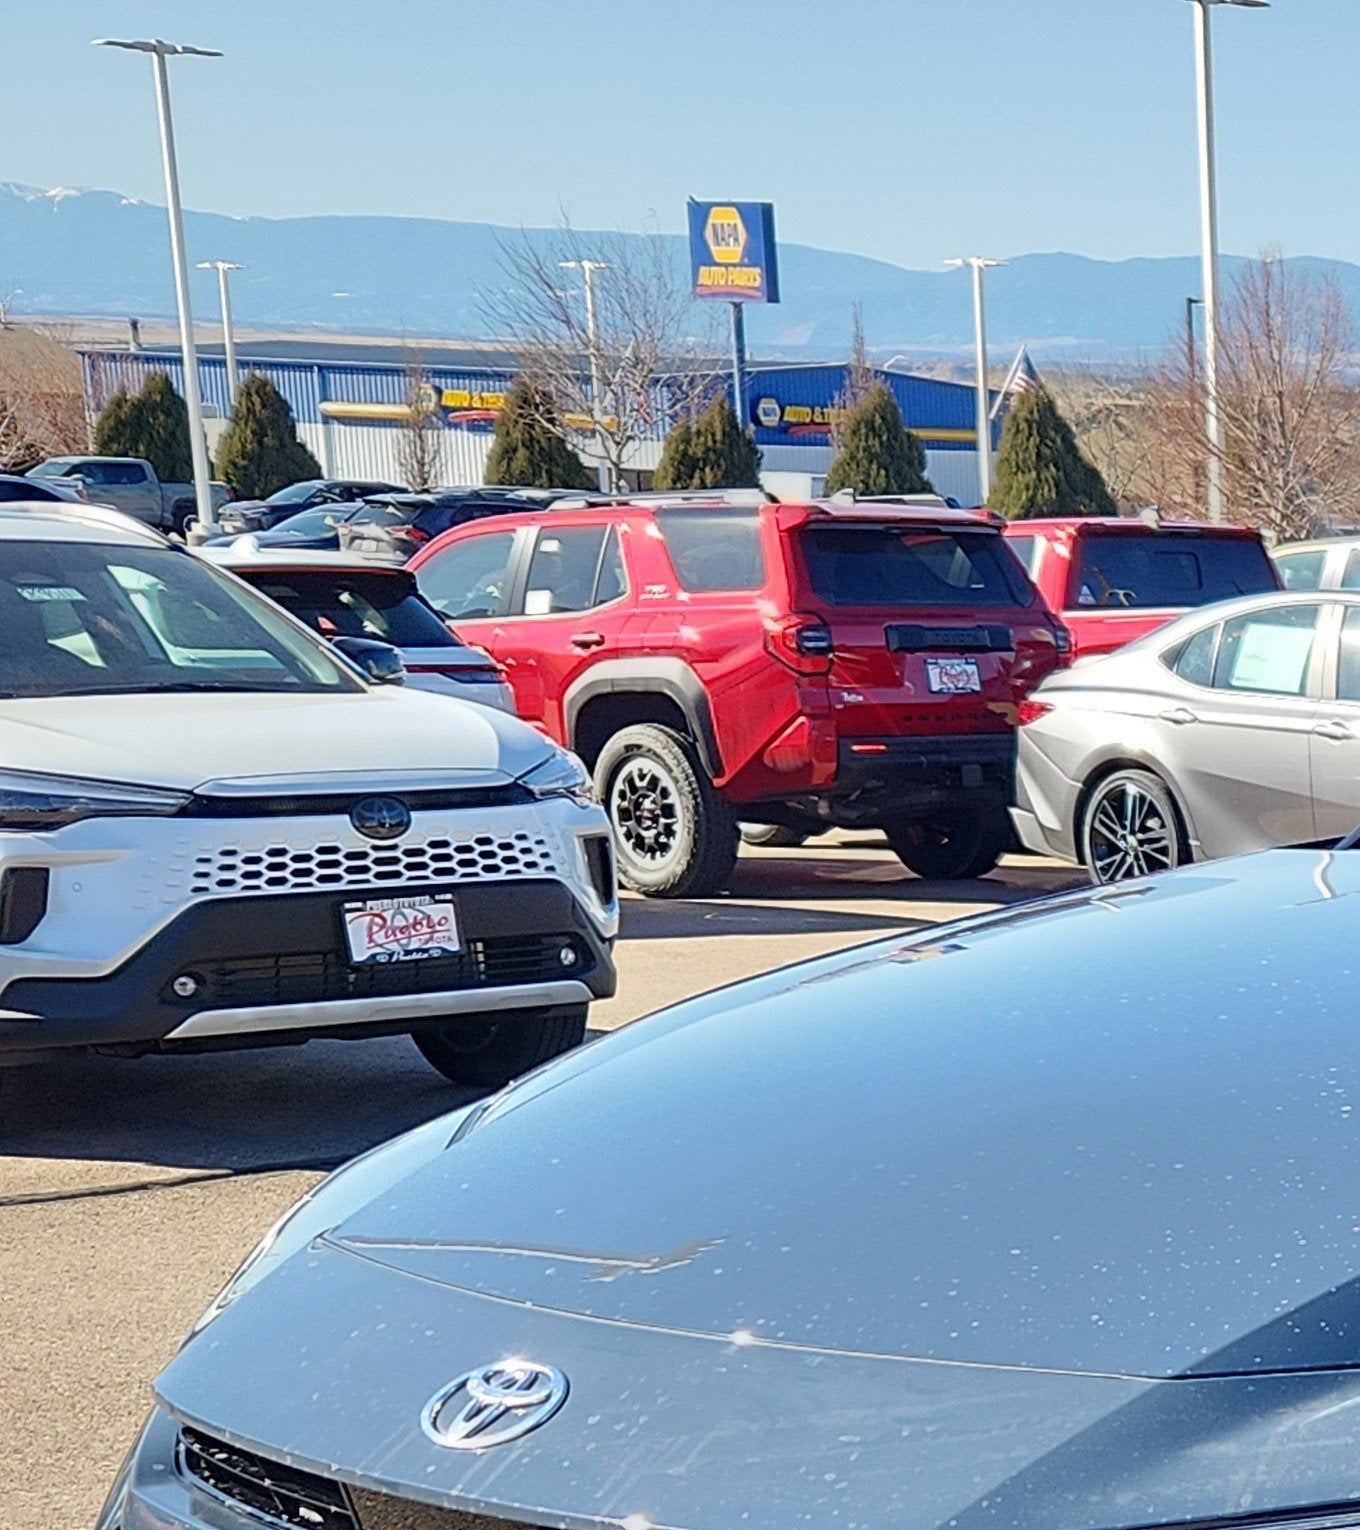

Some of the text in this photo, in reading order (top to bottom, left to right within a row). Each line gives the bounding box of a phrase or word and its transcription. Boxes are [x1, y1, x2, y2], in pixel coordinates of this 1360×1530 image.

[711, 222, 740, 248] NAPA
[697, 265, 762, 288] AUTO PARTS
[348, 912, 448, 945] Pueblo
